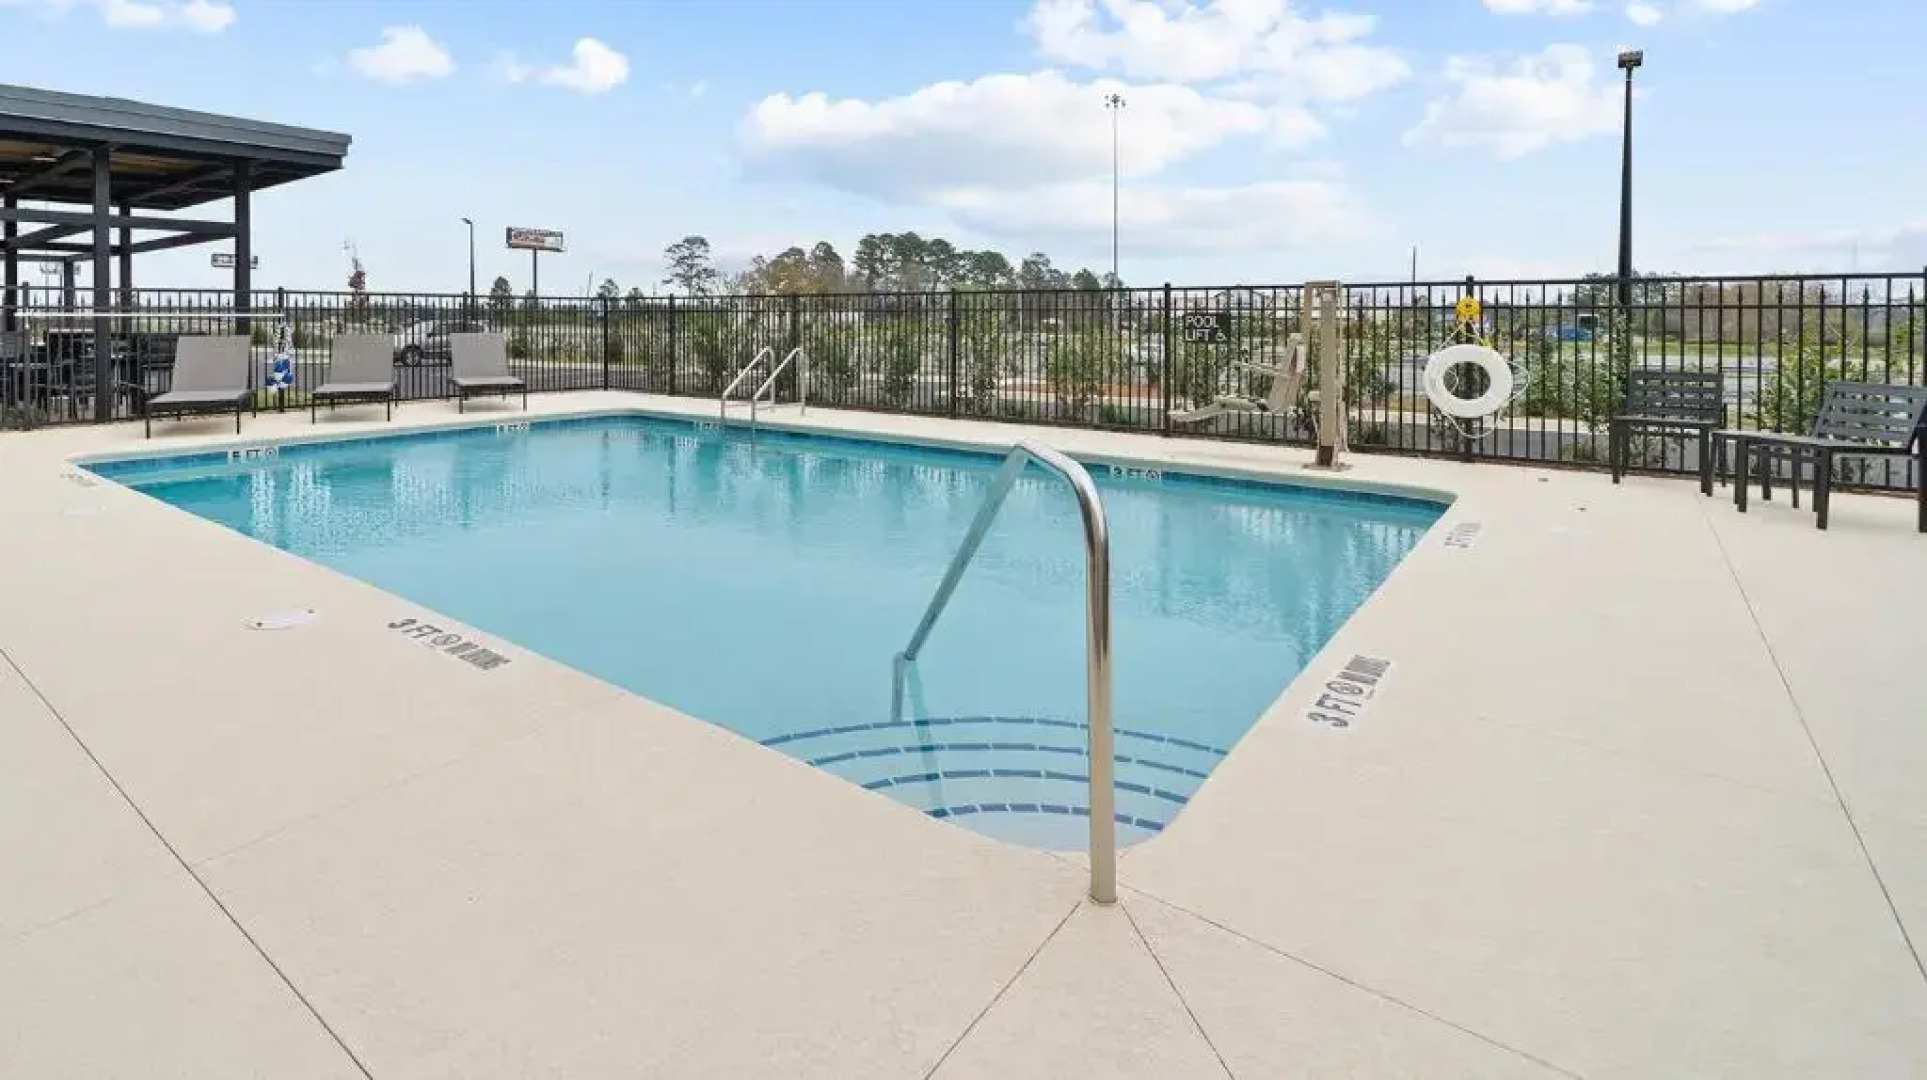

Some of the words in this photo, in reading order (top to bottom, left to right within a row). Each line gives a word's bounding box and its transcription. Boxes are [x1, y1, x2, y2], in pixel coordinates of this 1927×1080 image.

[1185, 315, 1219, 328] POOL
[1185, 328, 1210, 341] LIFT
[387, 618, 418, 629] 3
[401, 624, 443, 639] FT
[1315, 693, 1362, 716] FT
[1307, 712, 1348, 727] 3
